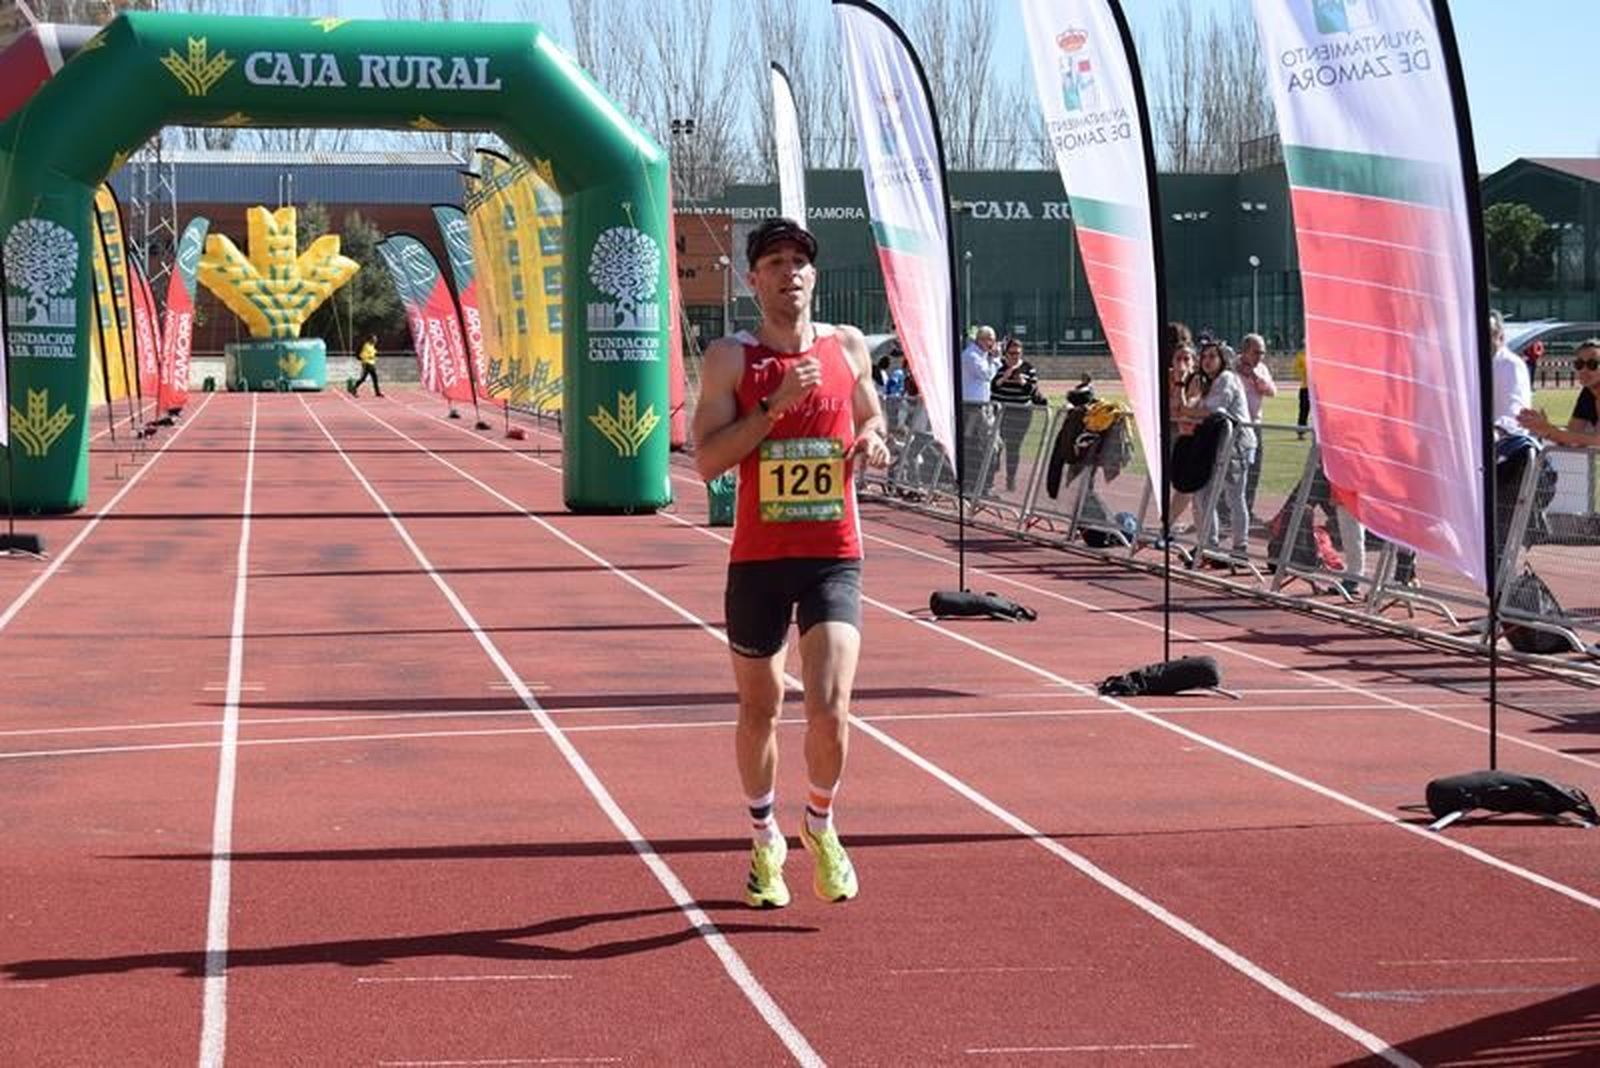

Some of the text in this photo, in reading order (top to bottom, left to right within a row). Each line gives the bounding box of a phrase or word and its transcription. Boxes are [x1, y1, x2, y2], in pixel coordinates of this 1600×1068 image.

[244, 51, 501, 91] CAJA RURAL
[807, 207, 866, 219] ZAMORA
[971, 201, 1032, 220] CAJA
[33, 346, 77, 358] RURAL
[173, 312, 191, 392] ZAMORA
[588, 349, 660, 361] CAJA RURAL
[770, 463, 832, 496] 126
